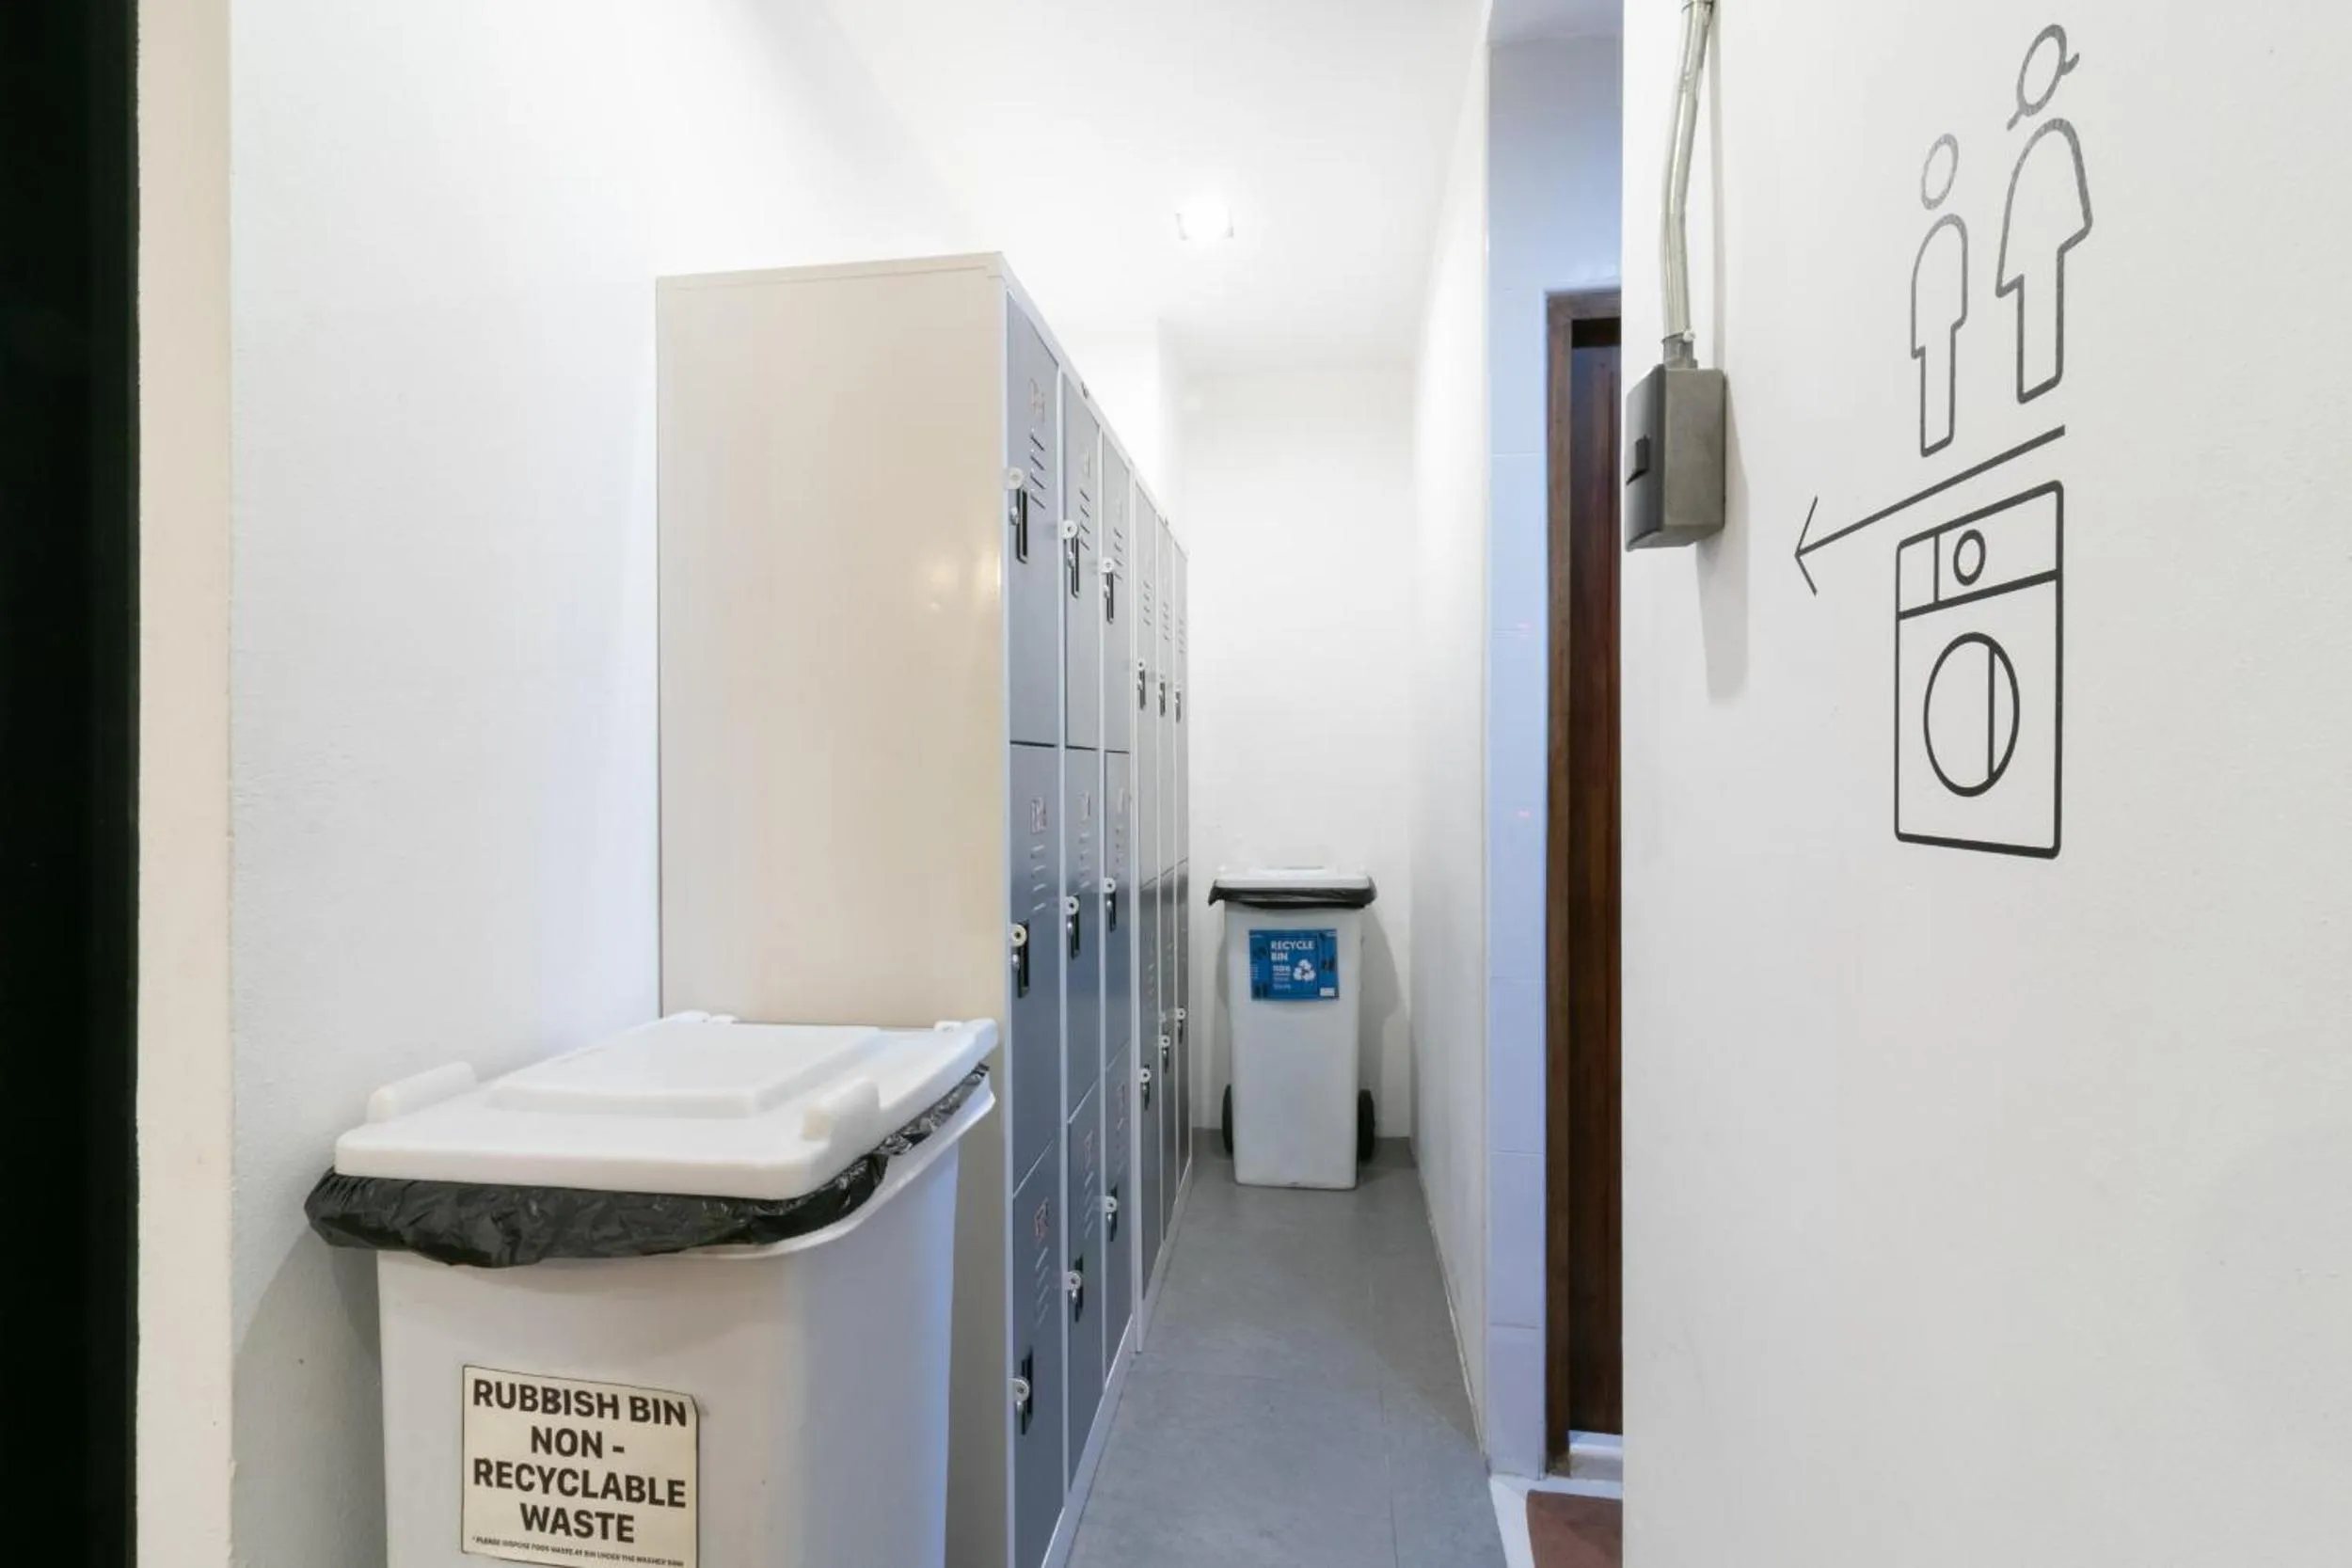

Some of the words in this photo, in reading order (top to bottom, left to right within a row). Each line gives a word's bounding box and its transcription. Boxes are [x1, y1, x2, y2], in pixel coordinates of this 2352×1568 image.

[1271, 940, 1314, 951] RECYCLE
[1271, 951, 1289, 961] BIN
[473, 1378, 620, 1420] RUBBISH
[628, 1395, 687, 1427] BIN
[531, 1425, 603, 1459] NON
[473, 1458, 687, 1509] RECYCLABLE
[519, 1502, 635, 1544] WASTE
